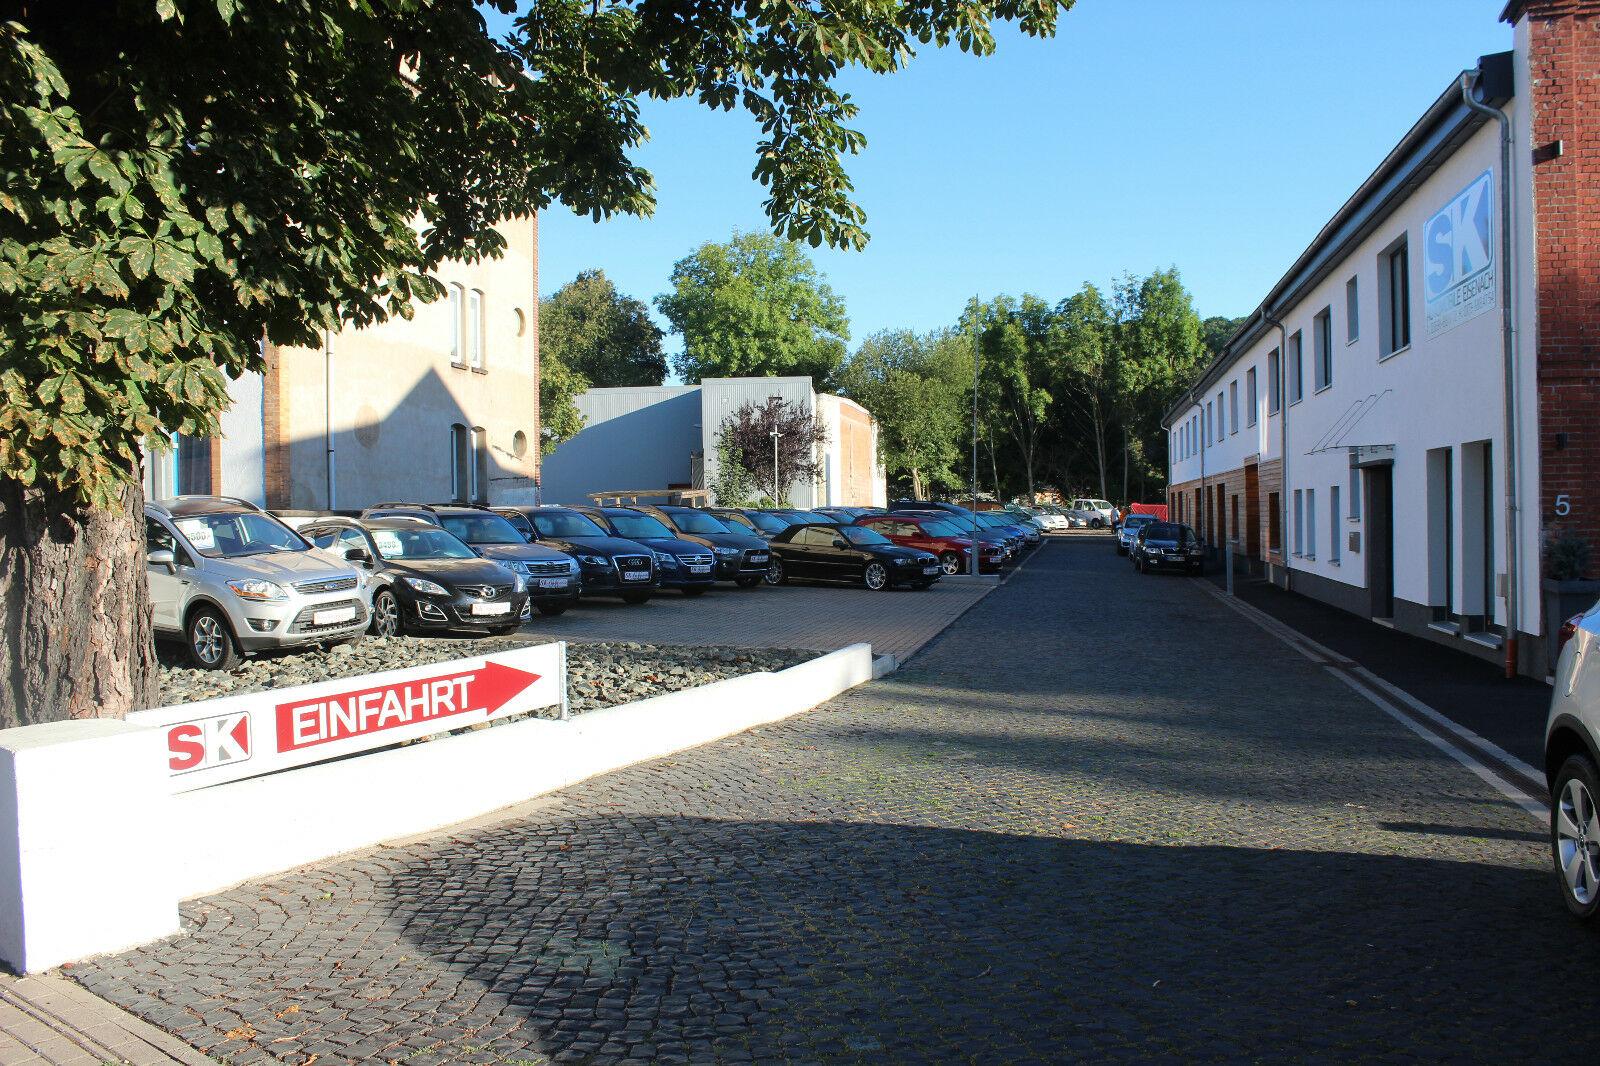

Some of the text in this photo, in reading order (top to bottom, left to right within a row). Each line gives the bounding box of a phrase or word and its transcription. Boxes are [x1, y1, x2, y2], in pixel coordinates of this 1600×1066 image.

[1427, 179, 1489, 294] SK
[1555, 494, 1571, 516] 5
[167, 675, 475, 770] SK EINFAHRT
